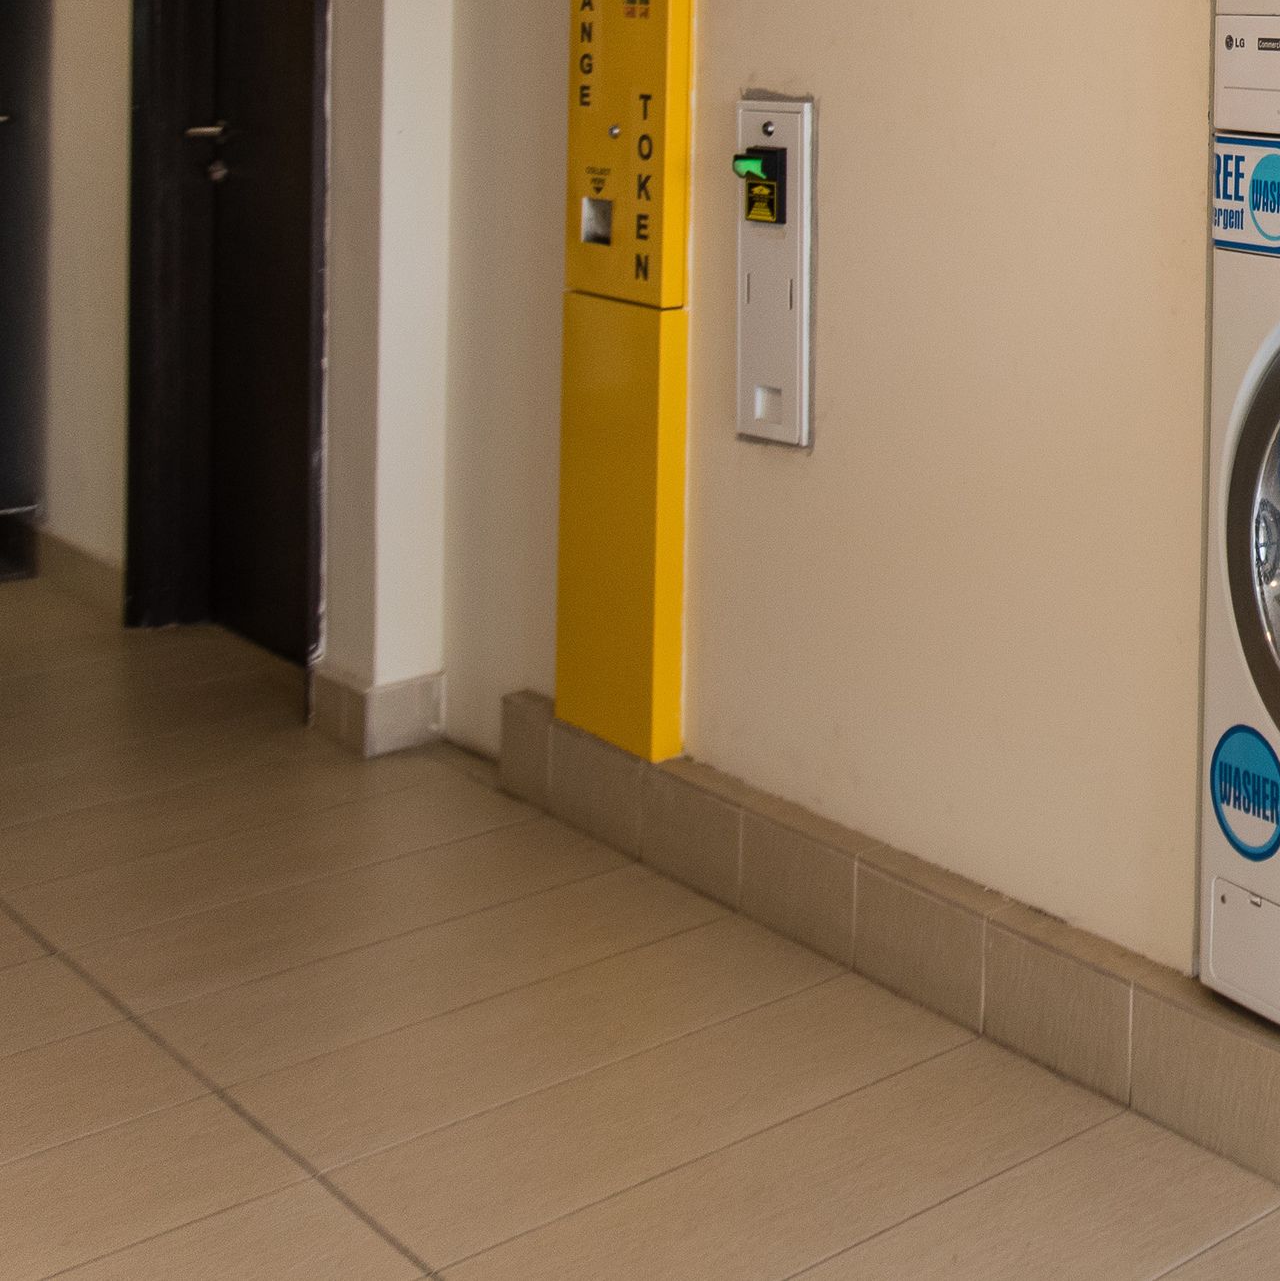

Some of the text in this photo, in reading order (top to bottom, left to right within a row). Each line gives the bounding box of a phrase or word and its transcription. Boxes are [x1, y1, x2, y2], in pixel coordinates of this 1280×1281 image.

[1235, 39, 1245, 49] LG
[635, 94, 653, 281] TOKEN
[1215, 153, 1245, 202] REE
[1219, 761, 1280, 824] WASHER
